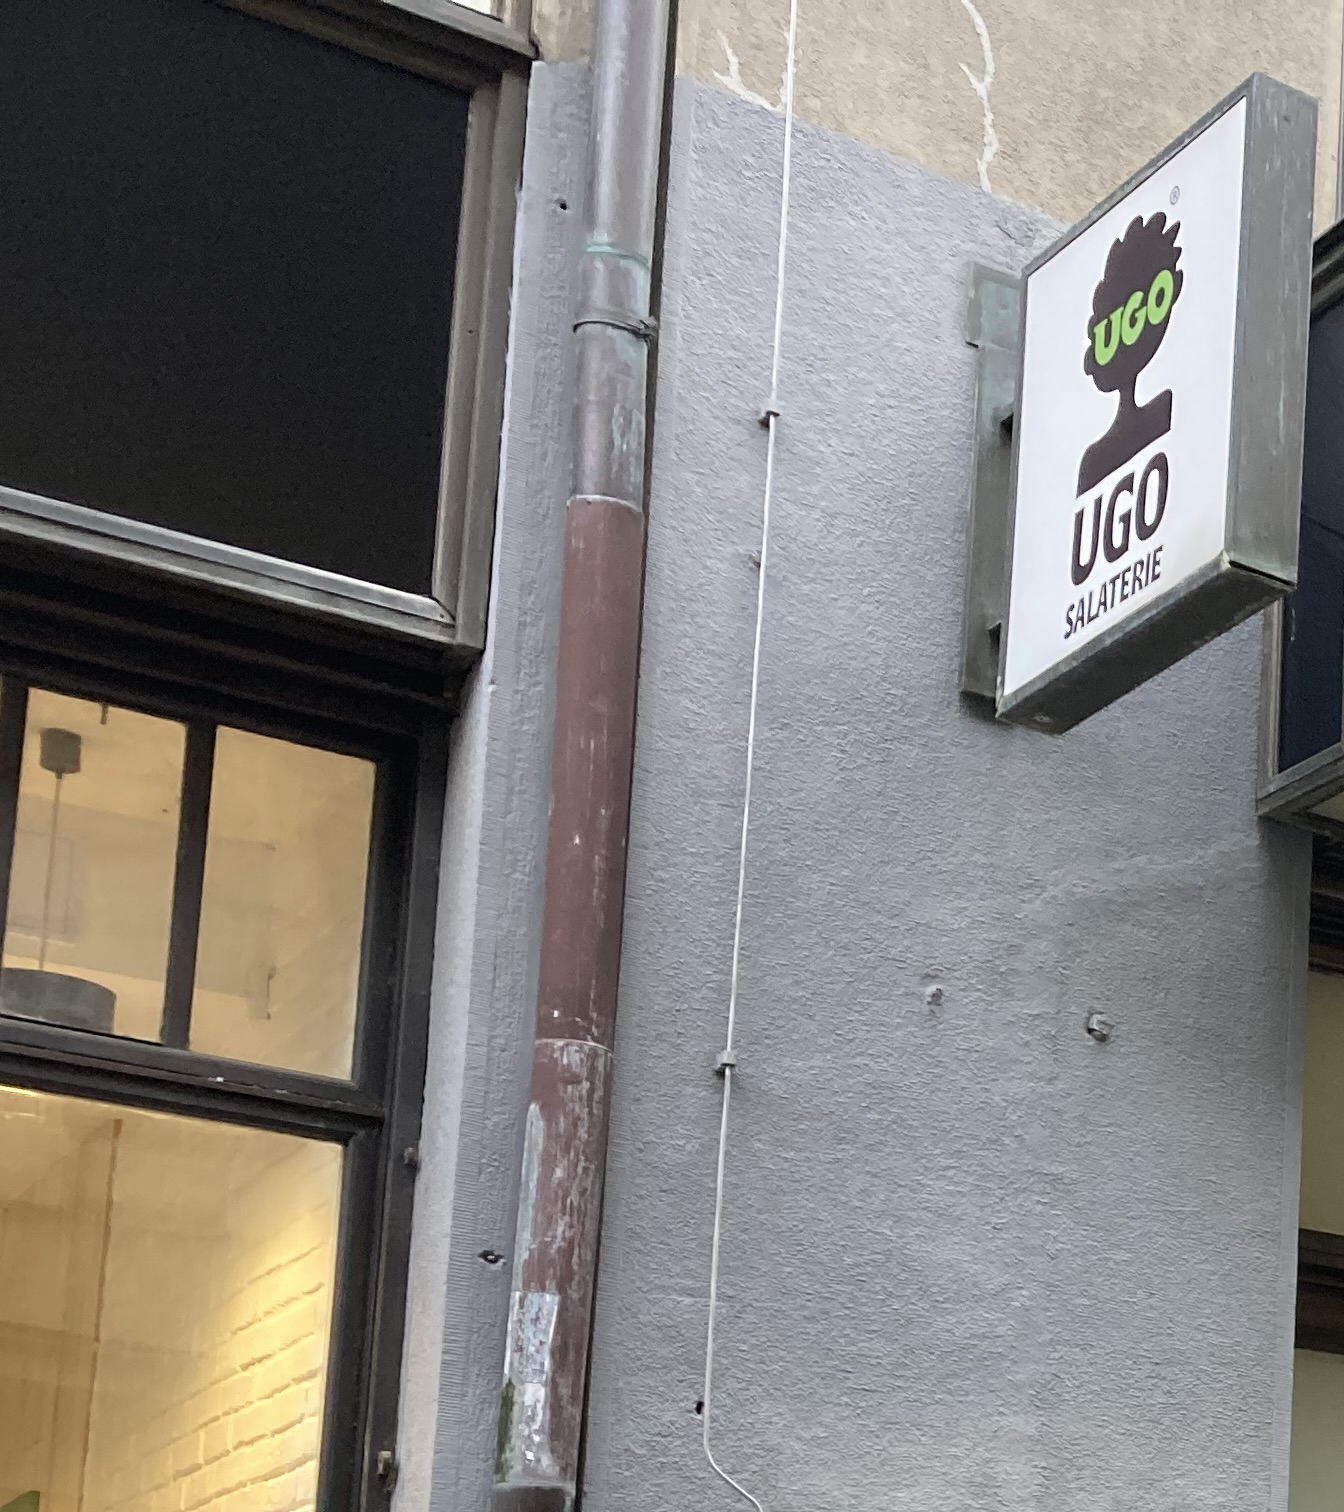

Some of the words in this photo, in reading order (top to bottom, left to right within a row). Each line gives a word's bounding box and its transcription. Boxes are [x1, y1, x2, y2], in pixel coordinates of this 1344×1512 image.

[1094, 269, 1174, 366] UGO
[1071, 451, 1169, 586] UGO
[1064, 545, 1163, 640] SALATERIE
